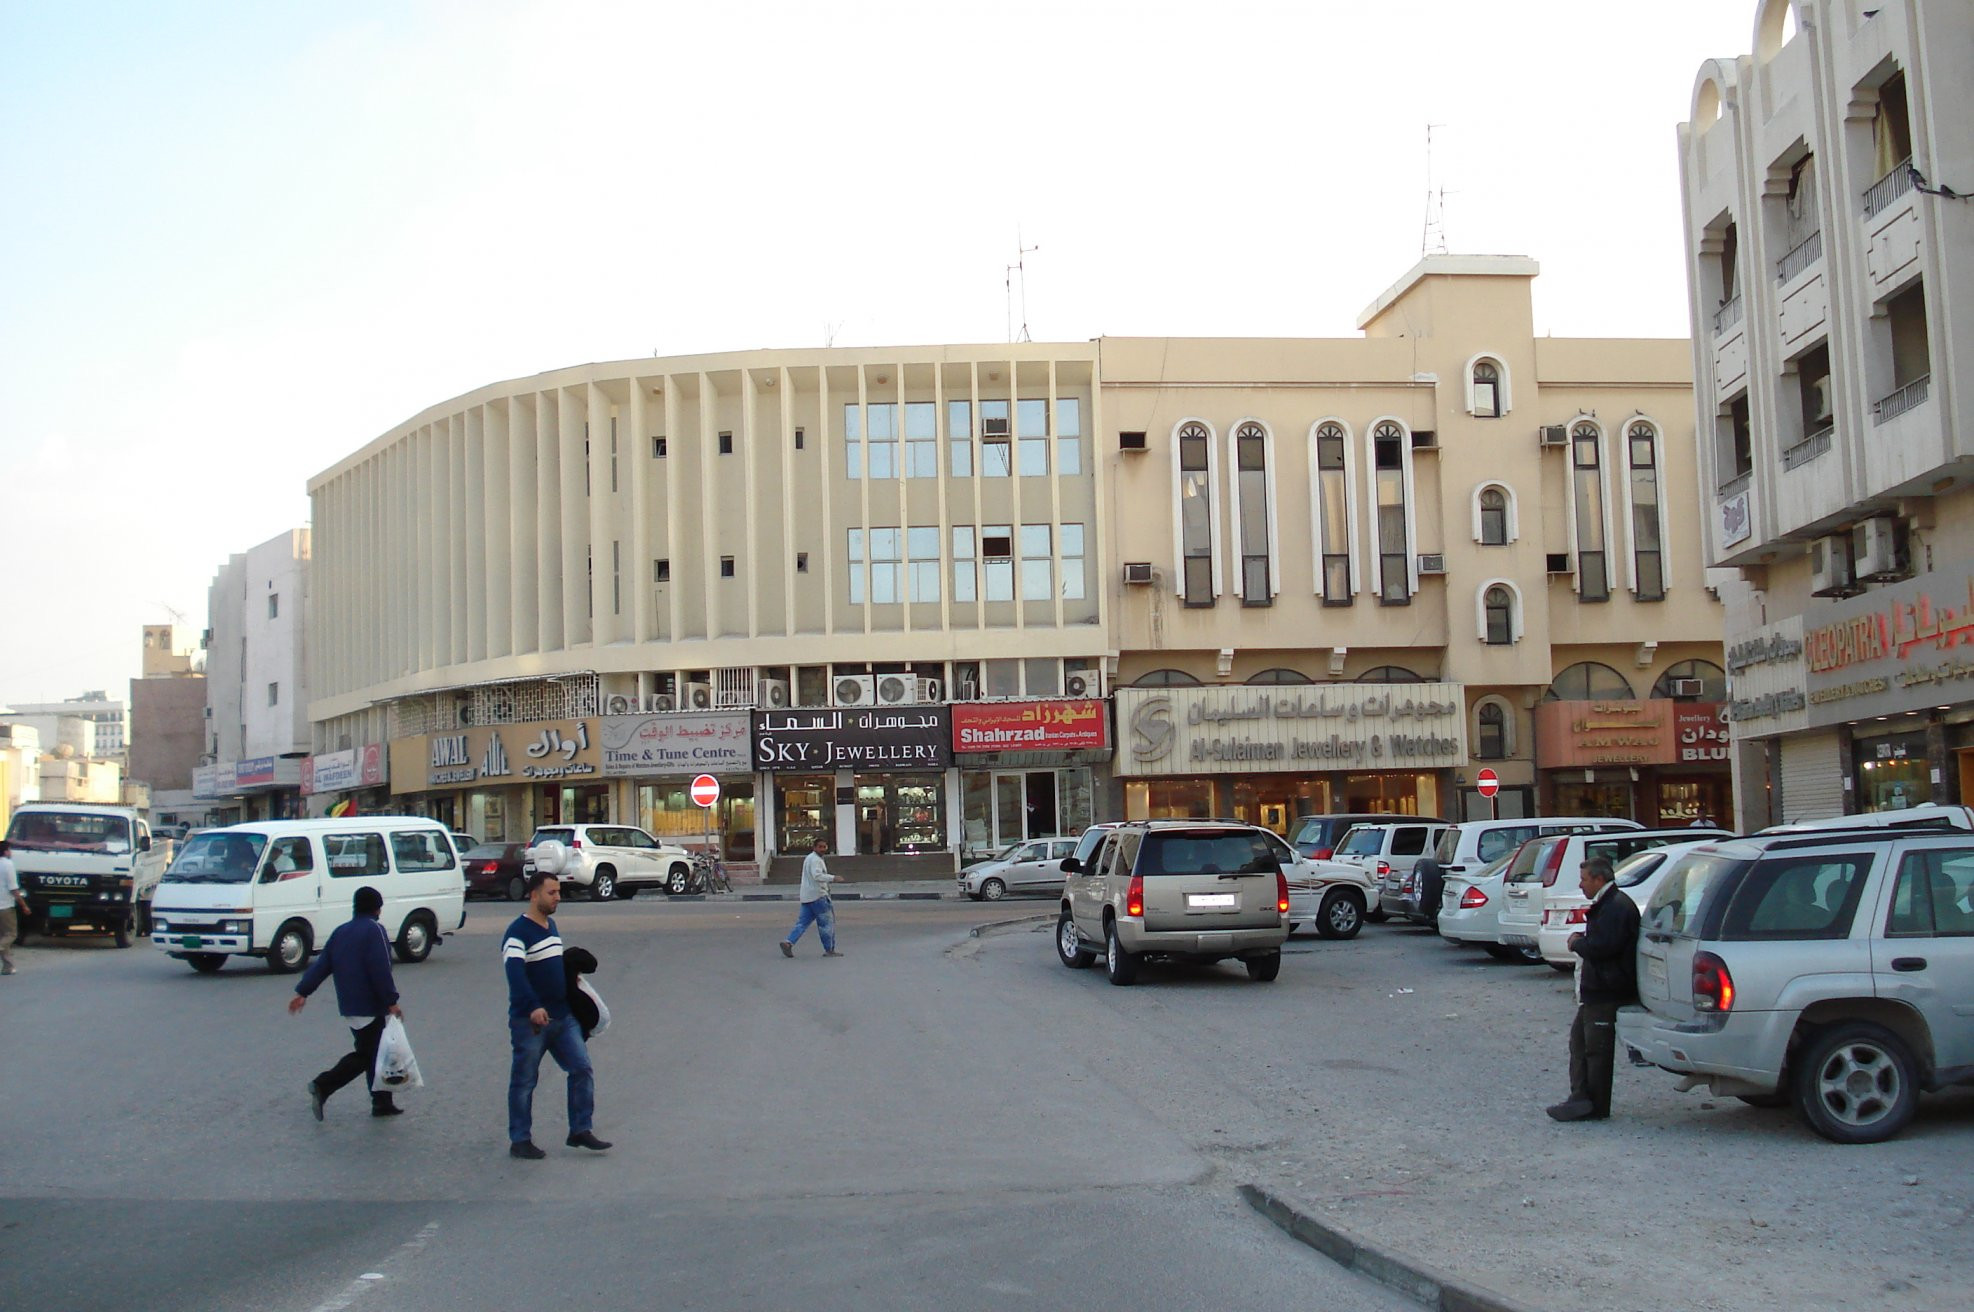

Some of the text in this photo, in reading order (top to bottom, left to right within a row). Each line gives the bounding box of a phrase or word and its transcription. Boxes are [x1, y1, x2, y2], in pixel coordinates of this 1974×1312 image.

[1804, 611, 1882, 674] CLEOPATRA
[759, 712, 938, 731] مجوهرات السماء
[1022, 700, 1097, 725] شهرزاد
[1679, 714, 1711, 723] Jewellery
[640, 722, 674, 741] الوقت
[719, 720, 747, 740] مركز
[960, 726, 1046, 743] Shahrzad
[527, 722, 588, 760] أوال
[759, 737, 938, 764] SKY JEWELLERY
[1190, 732, 1458, 763] Al-Sulaiman Jewellery & Watches
[431, 735, 470, 767] AWAL
[605, 747, 737, 762] Time & Tune Centre
[1593, 754, 1648, 763] JEWELLERY
[1682, 748, 1731, 761] BLU
[38, 875, 88, 886] TOYOTA
